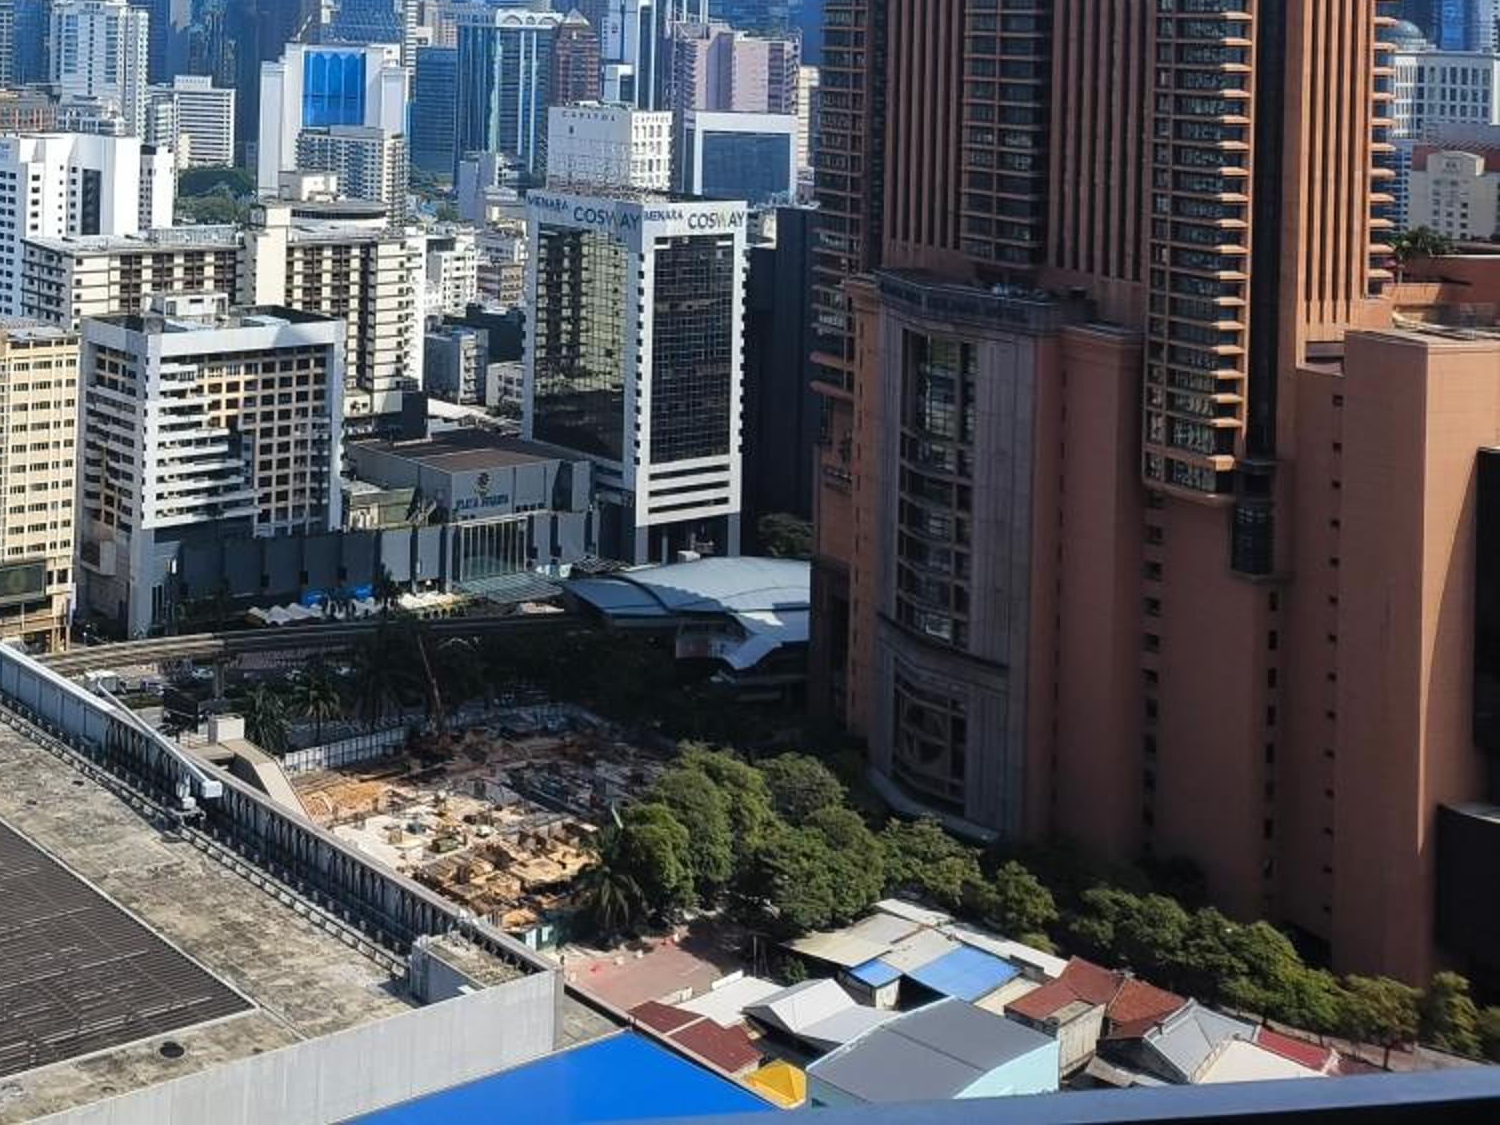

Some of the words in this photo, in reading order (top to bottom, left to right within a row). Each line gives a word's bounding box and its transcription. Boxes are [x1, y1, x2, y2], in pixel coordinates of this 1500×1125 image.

[527, 194, 569, 214] MENARA
[573, 205, 640, 227] COSWAY
[644, 209, 684, 222] MENARA
[688, 210, 746, 230] COSWAY
